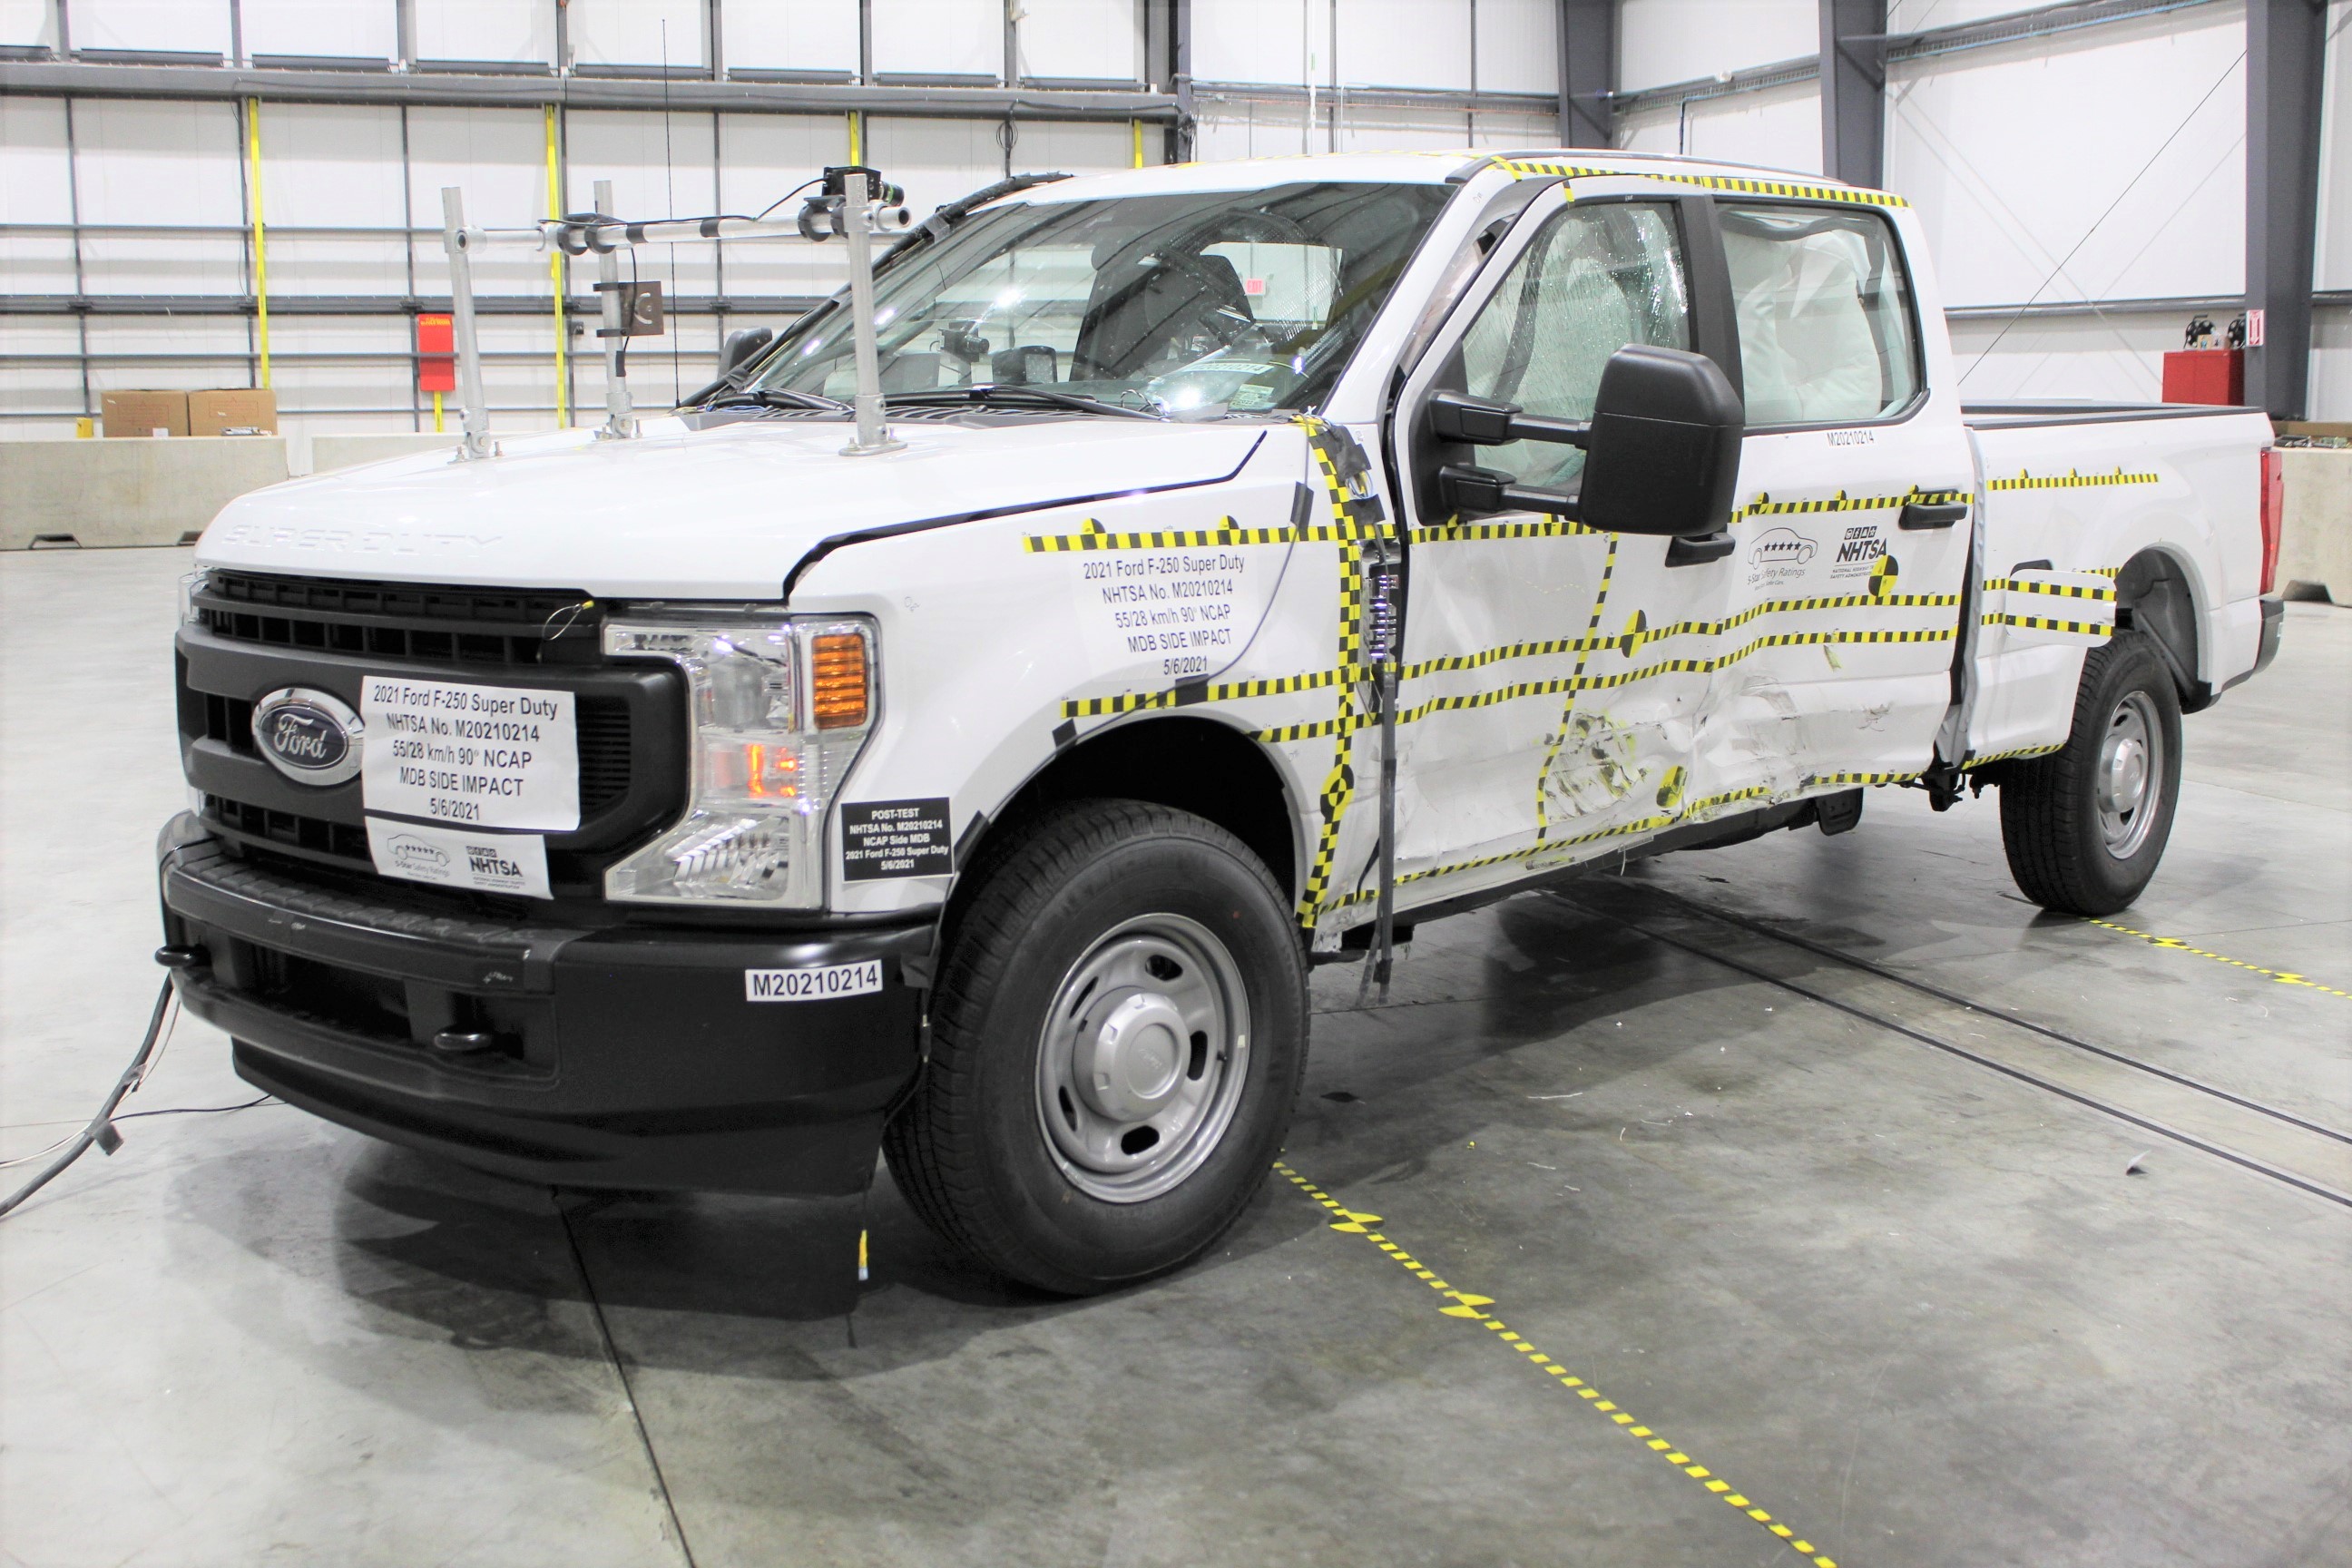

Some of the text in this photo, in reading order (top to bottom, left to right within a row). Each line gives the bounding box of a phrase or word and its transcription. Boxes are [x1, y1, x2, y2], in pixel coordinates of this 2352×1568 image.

[1827, 430, 1874, 446] M20210214
[1836, 538, 1887, 563] NHTSA
[1083, 554, 1244, 579] 2021 Ford F-250 Super Duty
[1779, 568, 1805, 579] Ratings
[1102, 579, 1233, 603] NHTSA No. M20210214
[1115, 611, 1148, 629] 55/28
[1150, 607, 1179, 625] km/h
[1200, 603, 1230, 622] NCAP
[1128, 629, 1231, 653] MDB SIDE IMPACT
[1163, 656, 1208, 675] 5/6/2021
[374, 685, 557, 720] 2021 Ford F-250 Super Duty
[274, 713, 327, 759] Ford
[387, 712, 540, 742] NHTSA No. M20210214
[392, 740, 424, 760] 55/28
[426, 743, 455, 763] km/h
[484, 750, 532, 769] NCAP
[399, 767, 524, 797] MDB SIDE IMPACT
[430, 798, 480, 820] 5/6/2021
[871, 808, 919, 819] POST-TEST
[849, 819, 943, 835] NHTSA No. M20210214
[846, 845, 948, 859] 2021 Ford F-250 Super Duty
[863, 833, 930, 847] NCAP Side MDB
[469, 857, 523, 877] NHTSA
[880, 859, 915, 870] 5/6/2021
[753, 965, 877, 996] M20210214
